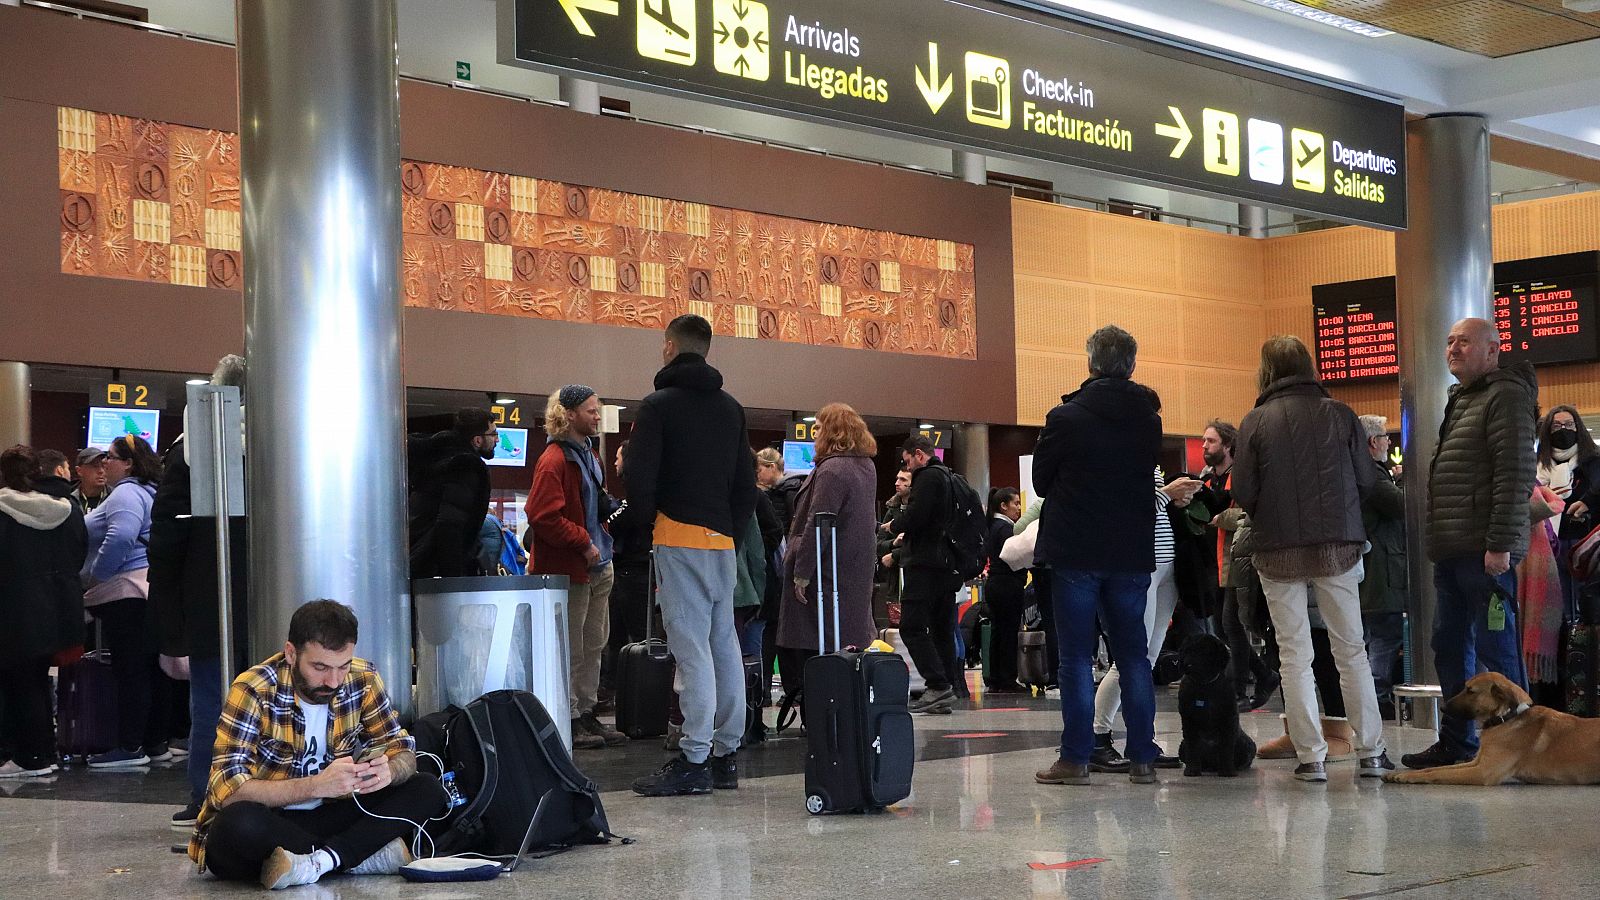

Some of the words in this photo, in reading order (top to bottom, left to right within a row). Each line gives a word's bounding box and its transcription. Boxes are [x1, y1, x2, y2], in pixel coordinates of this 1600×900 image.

[784, 15, 860, 58] Arrivals
[784, 51, 889, 103] Llegadas
[1022, 68, 1094, 108] Check-in
[1023, 102, 1132, 152] Facturación
[1332, 140, 1397, 176] Departures
[1333, 169, 1385, 204] Salidas
[1531, 290, 1571, 302] DELAYED
[1521, 307, 1526, 315] 2
[1531, 301, 1578, 314] CANCELED
[1319, 316, 1343, 326] 10:00
[1347, 313, 1373, 322] VIENA
[1531, 312, 1579, 325] CANCELED
[1319, 327, 1344, 337] 10:05
[1347, 322, 1394, 334] BARCELONA
[1532, 324, 1579, 337] CANCELED
[1320, 338, 1345, 348] 10:05
[1348, 333, 1395, 345] BARCELONA
[1320, 348, 1346, 358] 10:05
[1349, 344, 1395, 356] BARCELONA
[1321, 360, 1345, 369] 10:15
[1321, 371, 1346, 380] 14:10
[135, 385, 148, 406] 2
[509, 407, 521, 425] 4
[934, 431, 942, 446] 7
